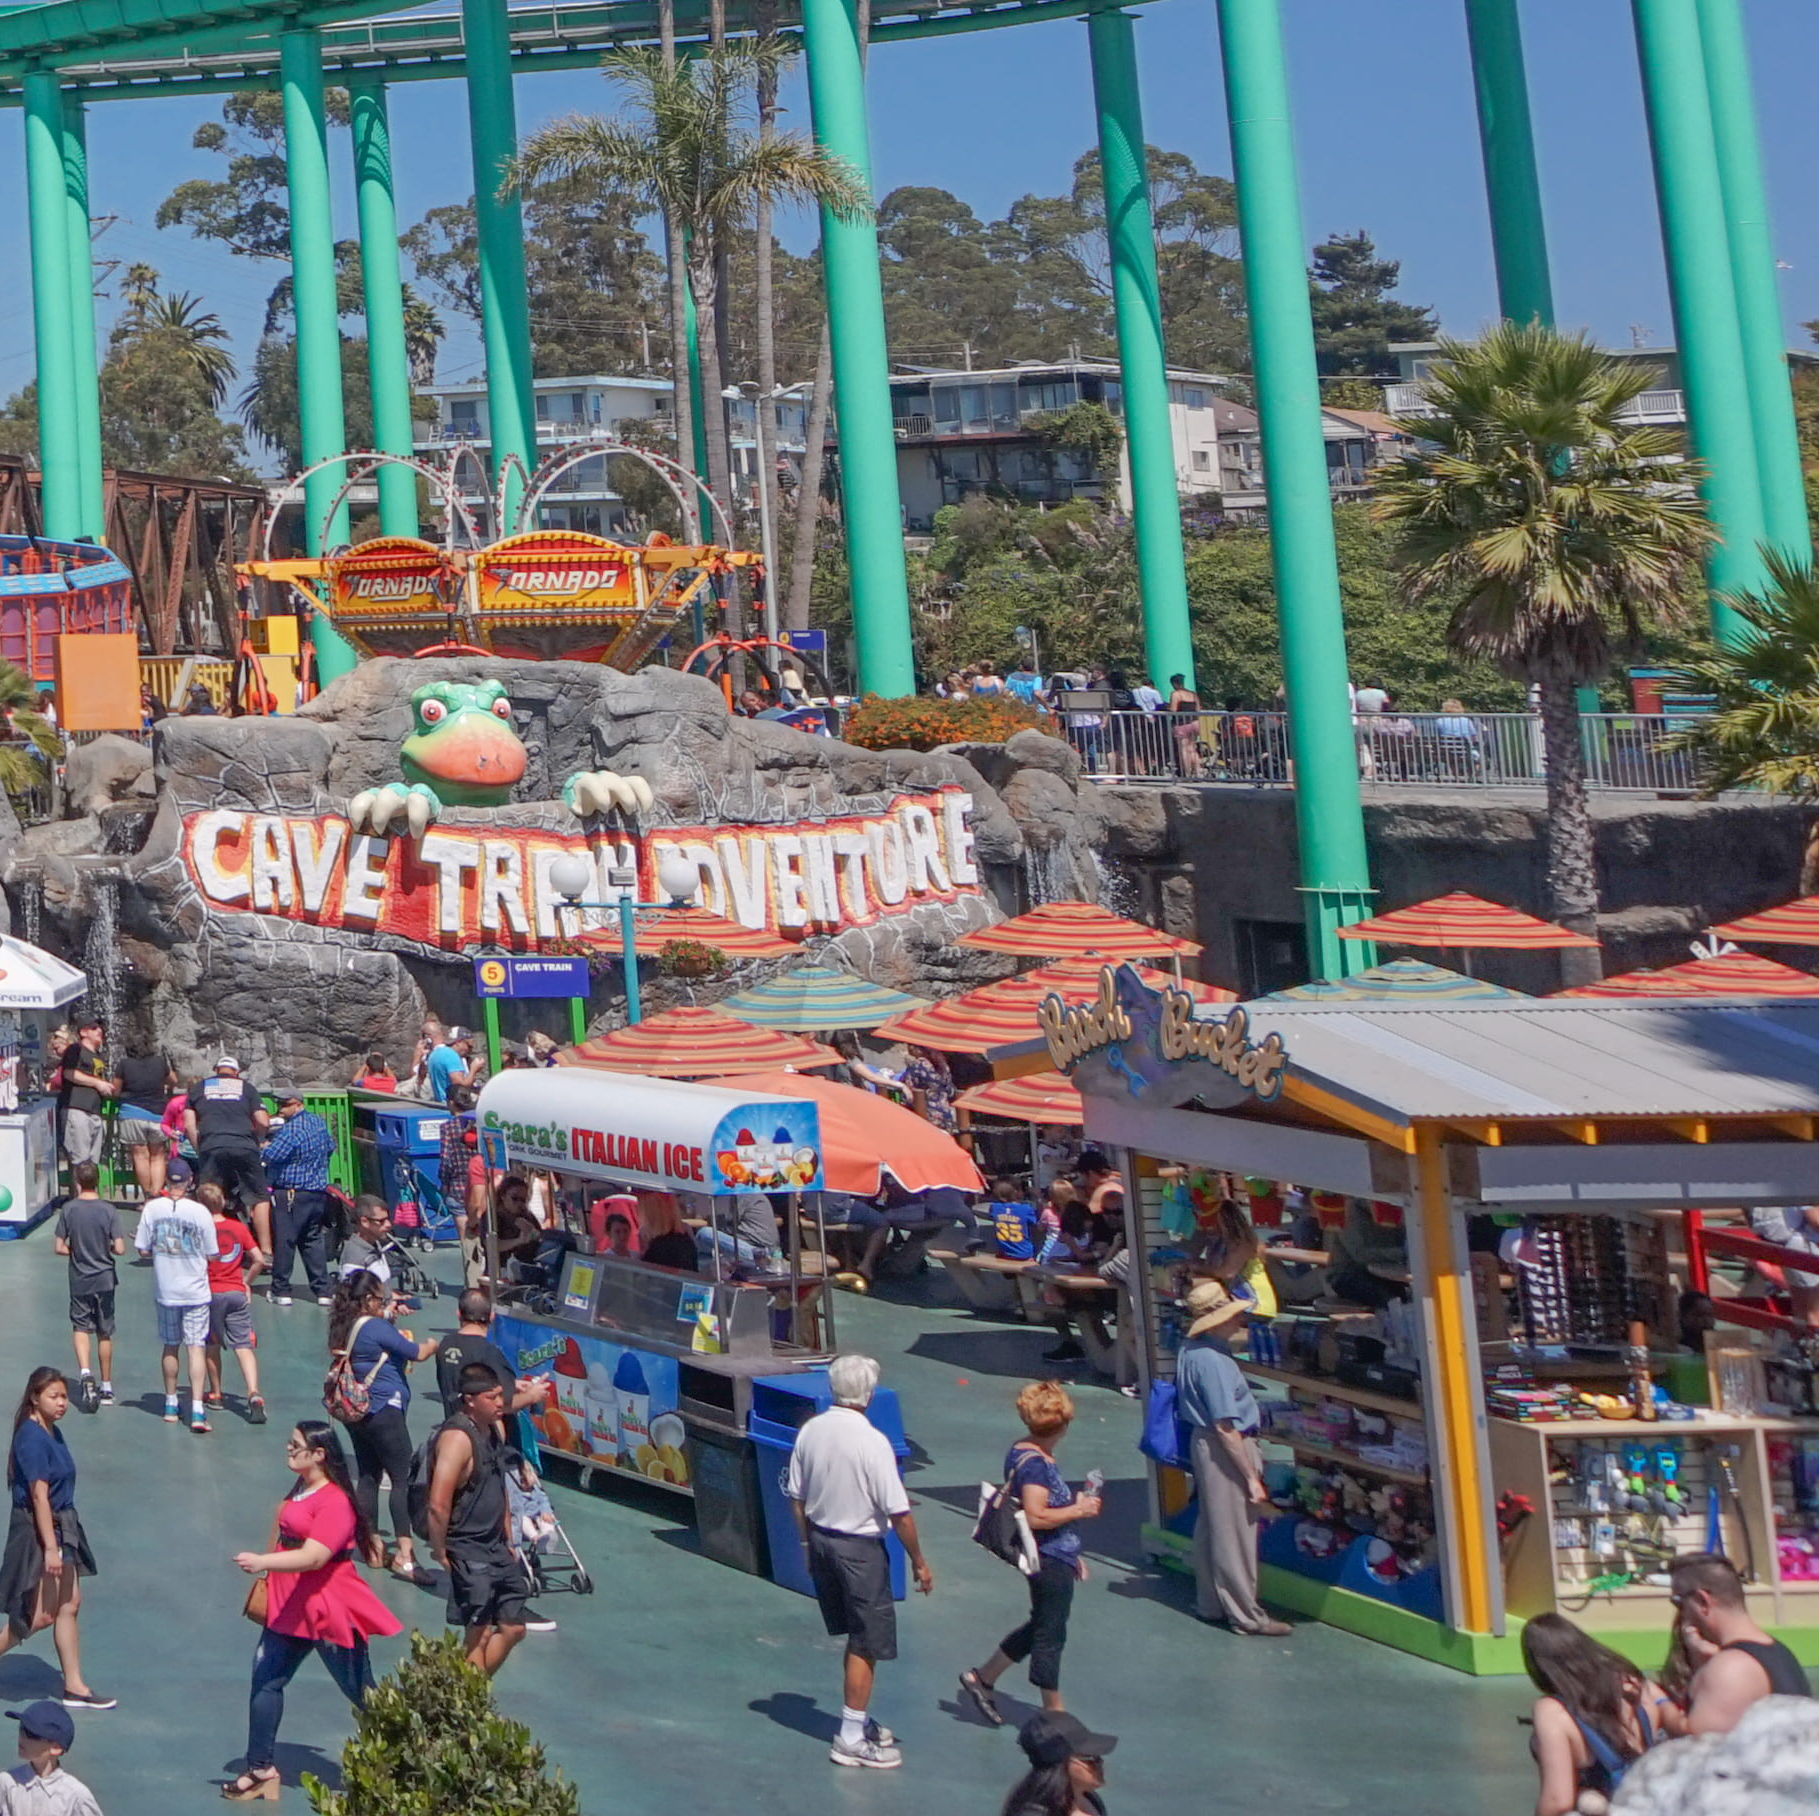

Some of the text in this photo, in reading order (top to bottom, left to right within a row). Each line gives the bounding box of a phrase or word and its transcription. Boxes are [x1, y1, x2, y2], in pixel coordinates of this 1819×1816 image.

[490, 568, 618, 599] TORNADO
[192, 809, 389, 920] CAVE
[421, 836, 638, 937] TRAIN
[487, 967, 498, 980] 5
[515, 963, 573, 972] CAVE TRAIN
[1037, 965, 1286, 1098] Beach Bucket
[484, 1111, 568, 1152] Scara's
[571, 1127, 659, 1175] ITALIAN
[663, 1142, 705, 1183] ICE
[995, 1222, 1024, 1242] 35
